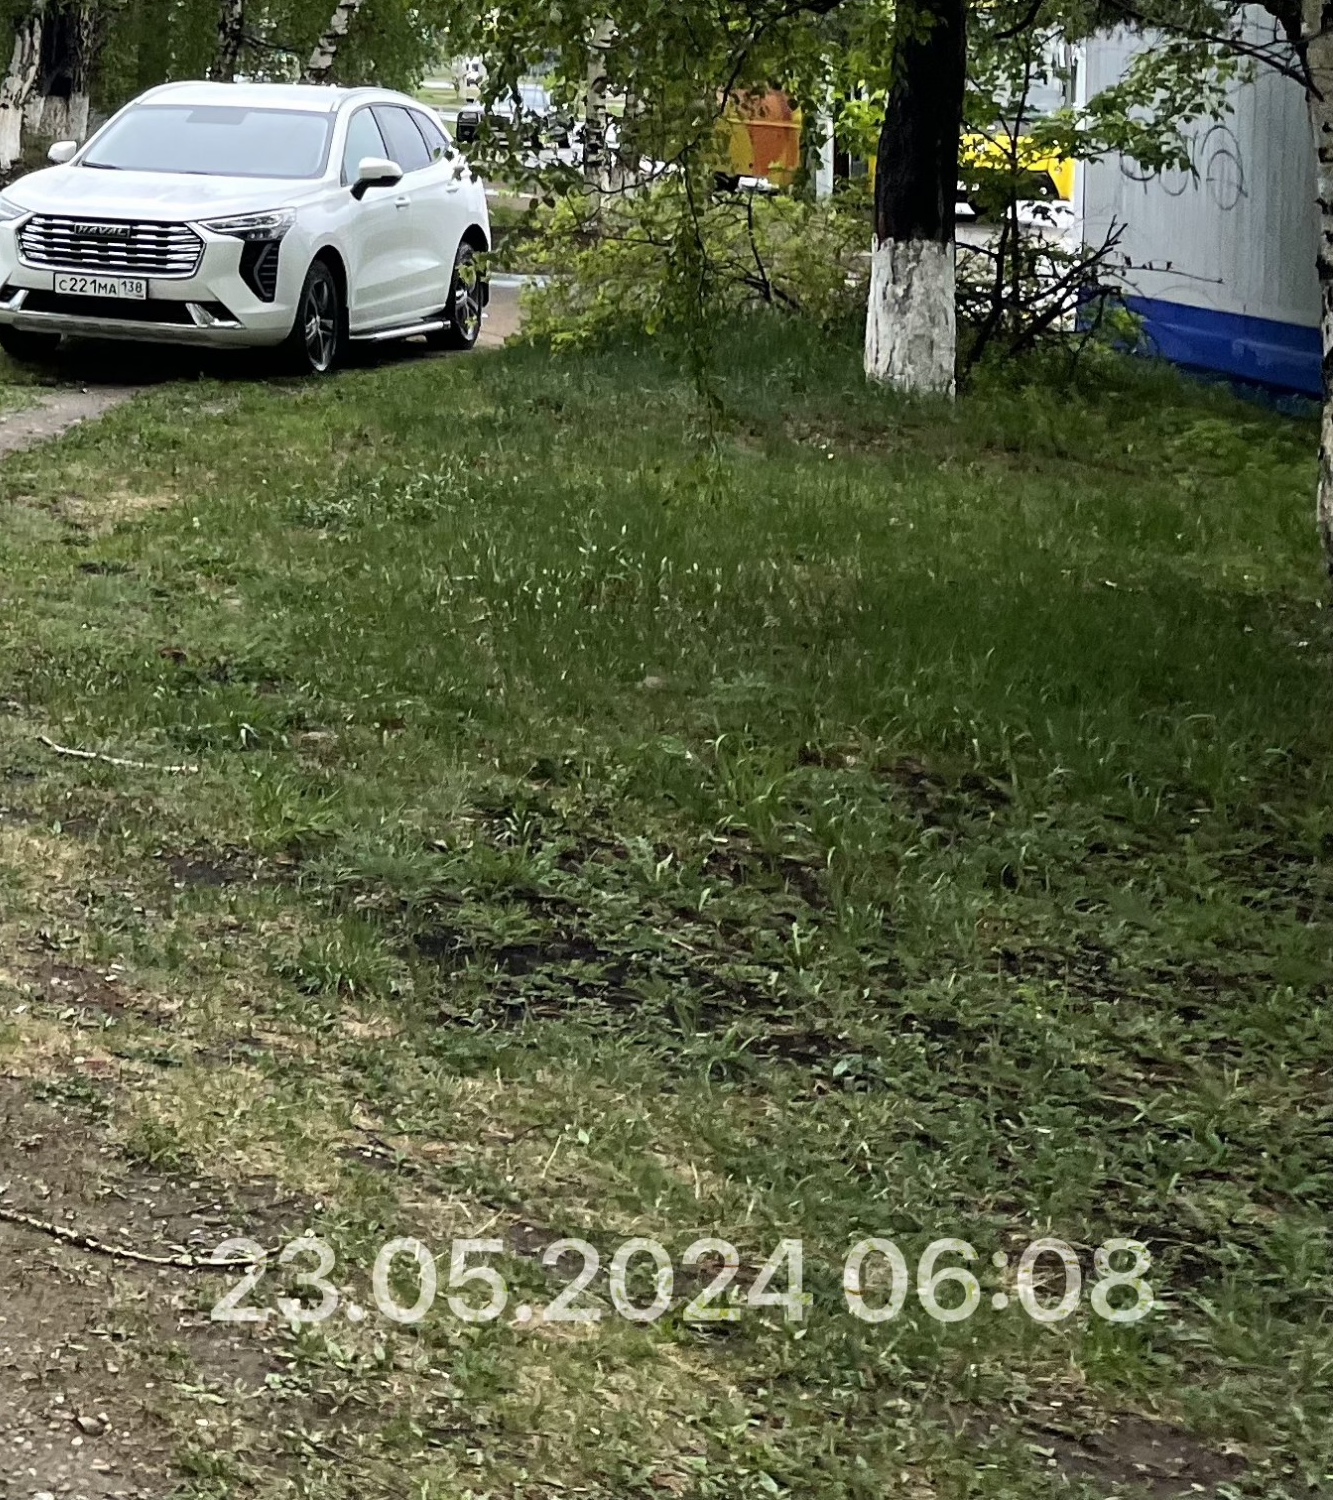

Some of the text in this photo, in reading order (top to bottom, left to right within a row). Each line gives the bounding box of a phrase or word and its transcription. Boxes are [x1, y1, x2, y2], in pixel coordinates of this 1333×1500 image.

[78, 225, 127, 237] HAVAL
[59, 277, 143, 295] С221МА 138
